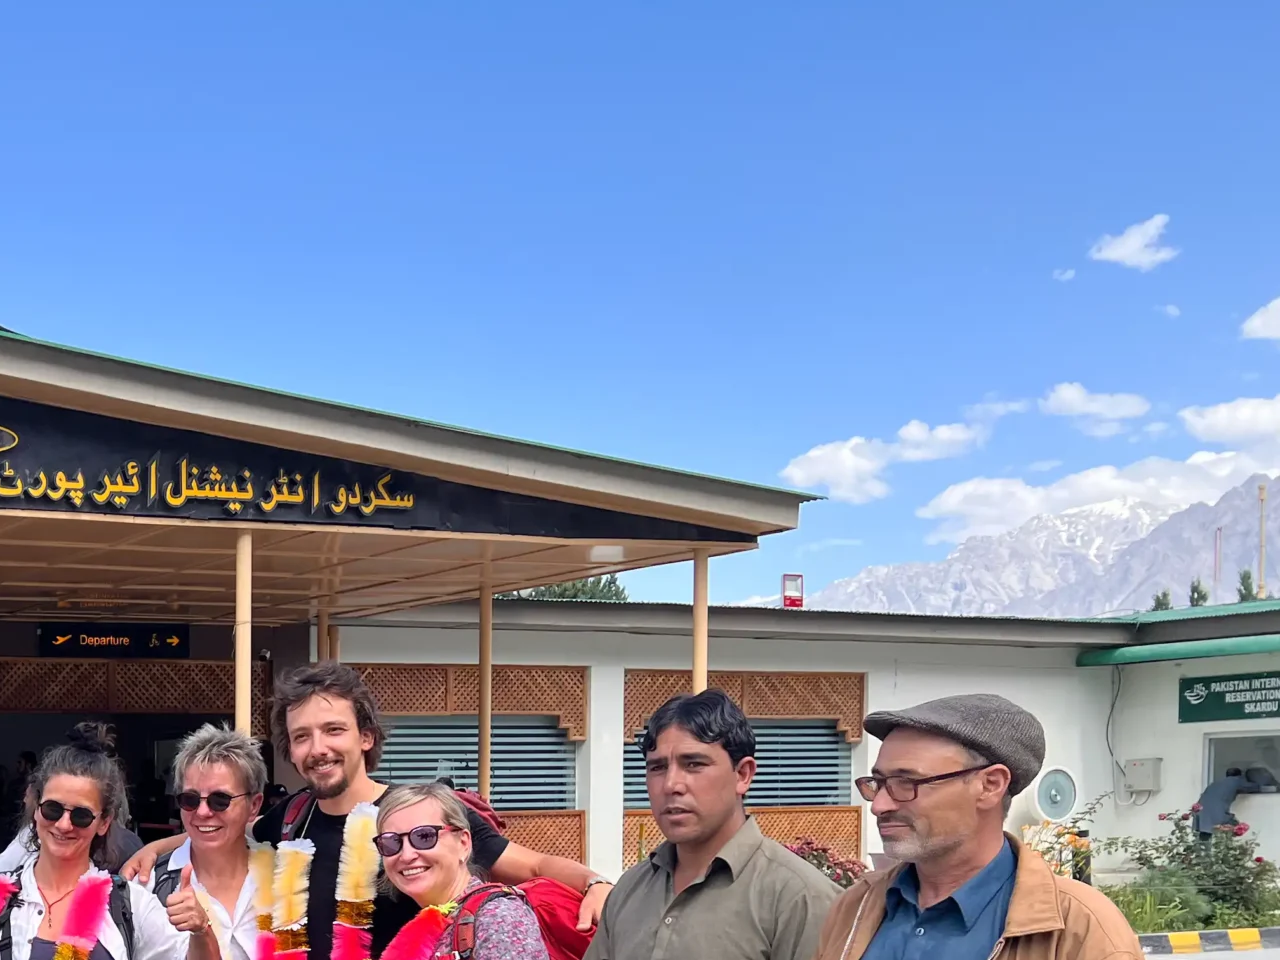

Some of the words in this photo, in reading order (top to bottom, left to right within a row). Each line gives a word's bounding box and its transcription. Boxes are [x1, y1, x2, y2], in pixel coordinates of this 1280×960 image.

[331, 473, 415, 513] سکردو
[79, 634, 130, 647] Departure
[1210, 680, 1250, 693] PAKISTAN
[1225, 689, 1280, 703] RESERVATION
[1244, 700, 1279, 713] SKARDU
